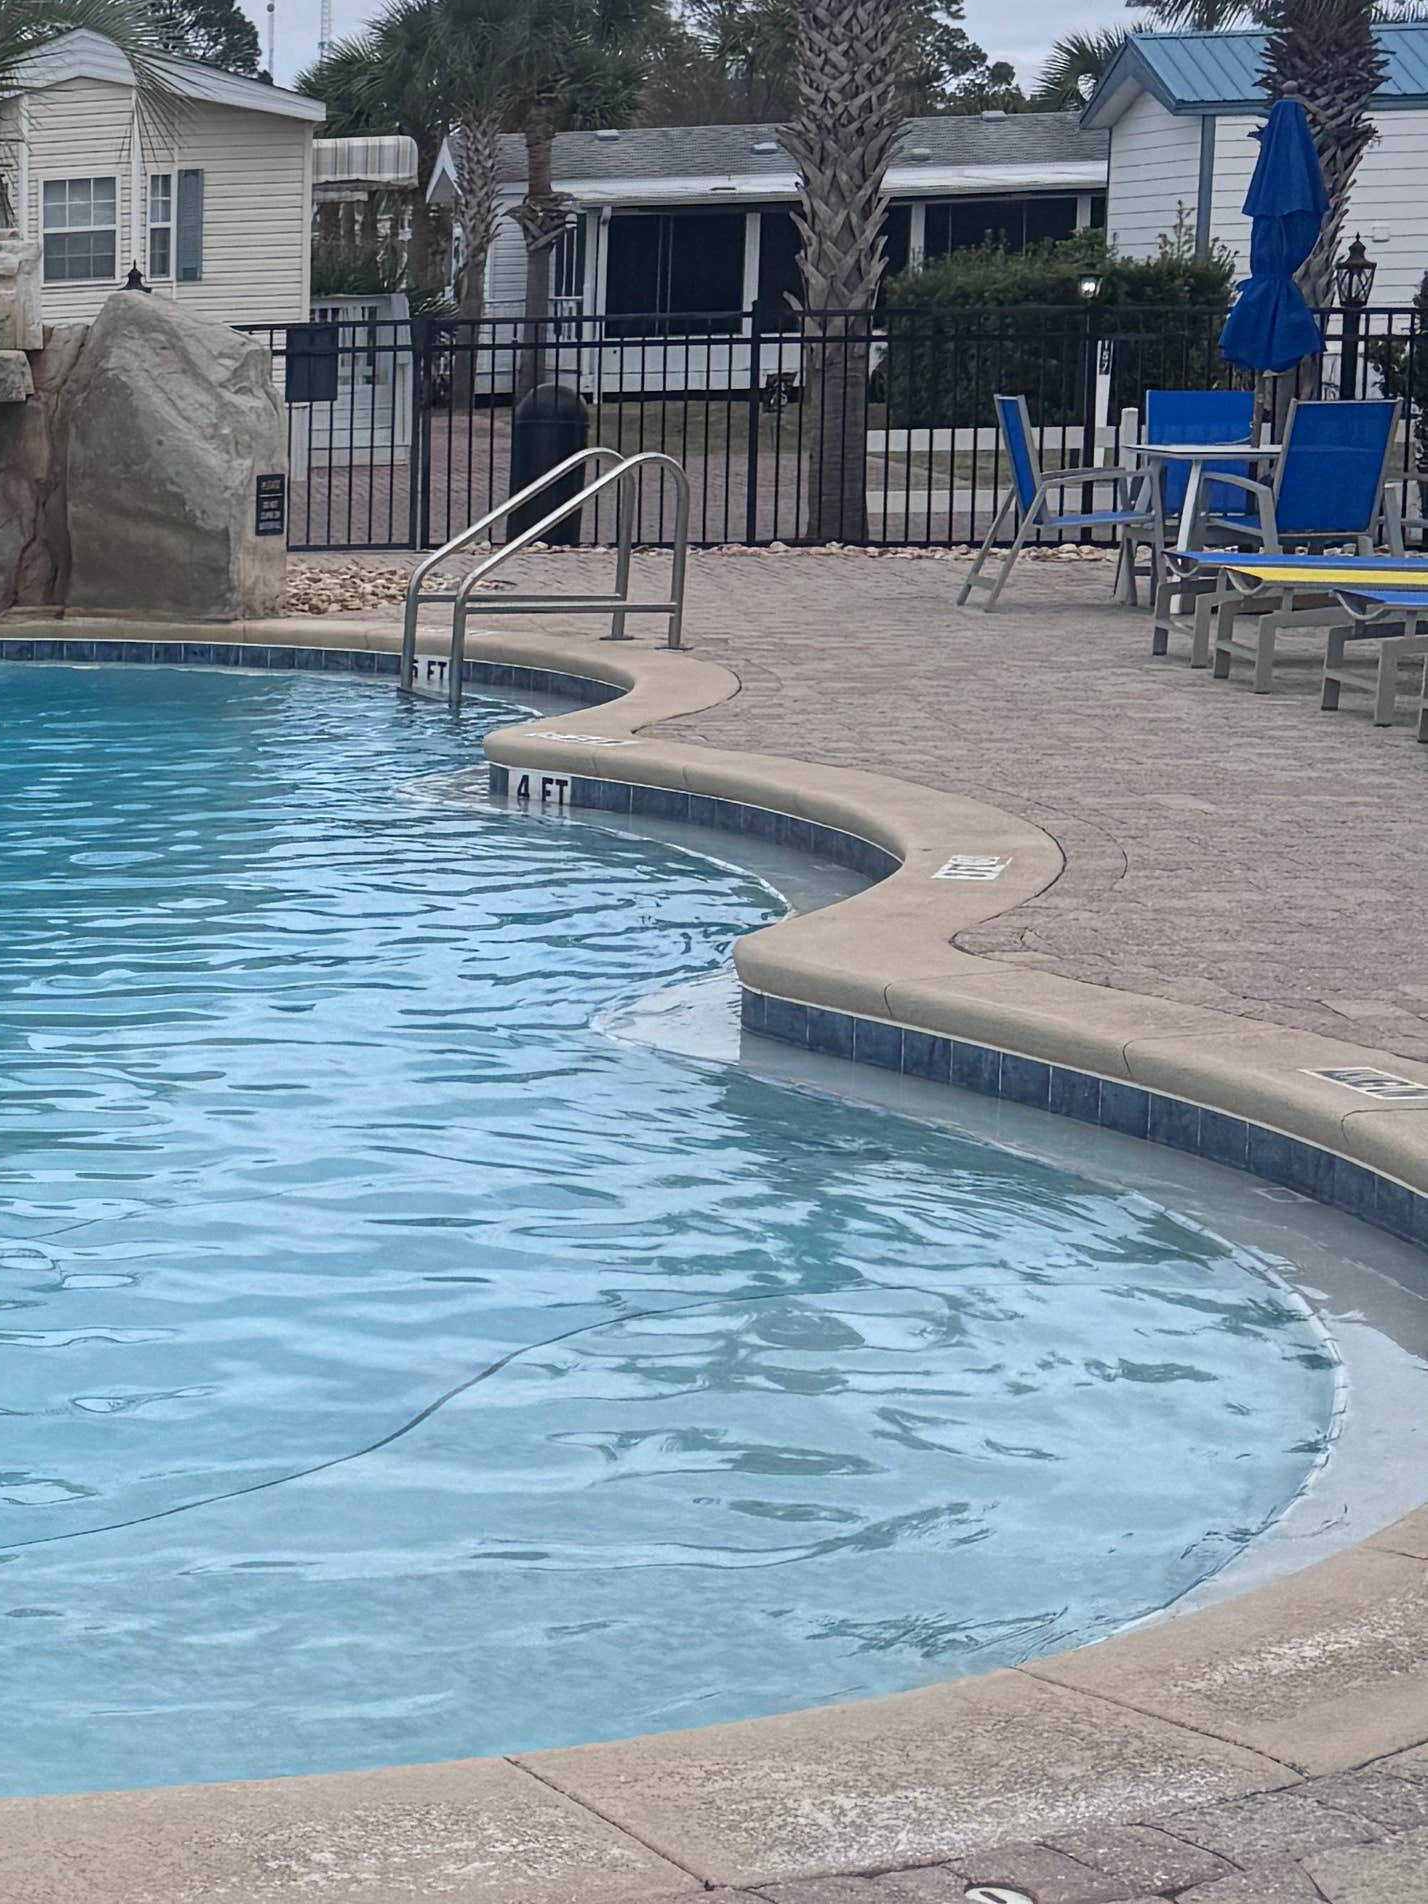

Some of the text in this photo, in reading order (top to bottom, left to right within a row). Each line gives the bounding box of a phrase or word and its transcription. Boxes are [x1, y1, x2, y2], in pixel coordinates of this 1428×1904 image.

[427, 660, 447, 680] FT
[517, 775, 568, 805] 4 FT
